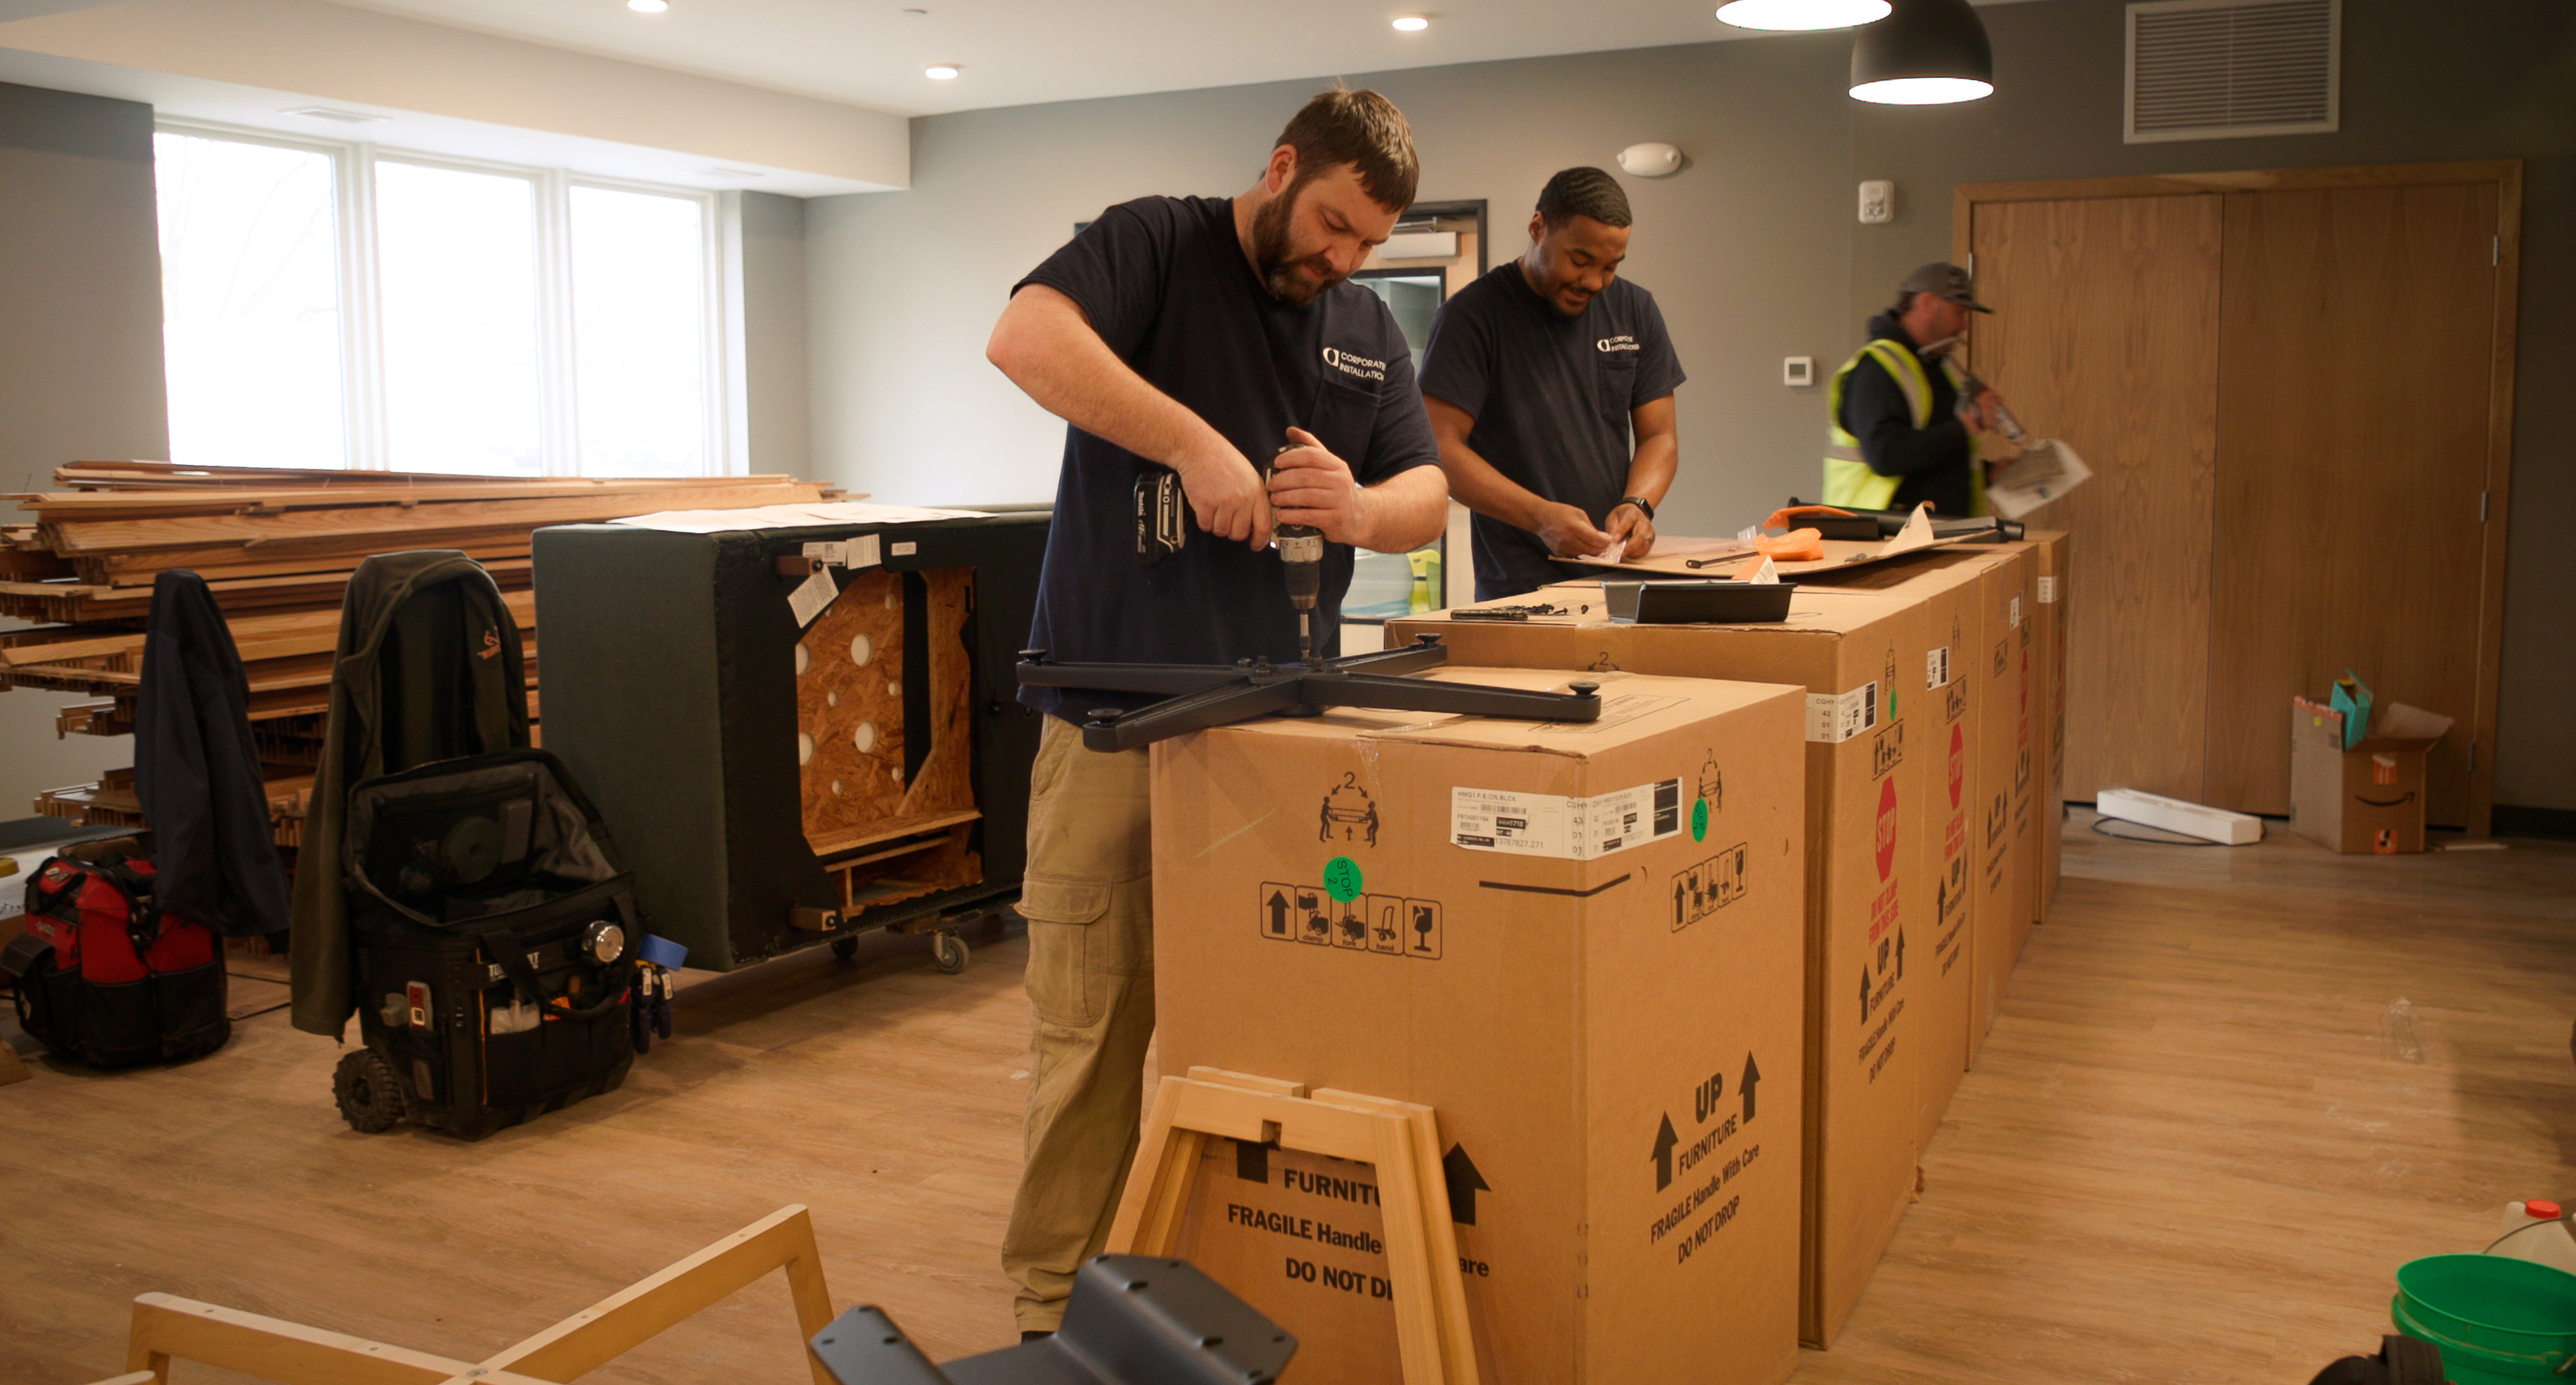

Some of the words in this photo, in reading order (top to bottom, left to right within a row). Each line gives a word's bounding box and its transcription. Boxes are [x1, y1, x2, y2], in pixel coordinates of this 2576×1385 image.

[1341, 352, 1387, 371] CORPORATE
[1599, 652, 1609, 666] 2
[1344, 771, 1356, 789] 2
[1328, 877, 1338, 886] 2
[1337, 860, 1353, 898] STOP
[1878, 937, 1889, 976] UP
[1695, 1073, 1723, 1124] UP
[1679, 1113, 1738, 1177] FURNITURE
[1284, 1168, 1381, 1208] FURNIT
[1651, 1195, 1692, 1245] FRAGILE
[1693, 1174, 1721, 1211] Handle
[1723, 1156, 1741, 1185] With
[1742, 1143, 1760, 1168] Care
[1228, 1203, 1313, 1239] FRAGILE
[1317, 1221, 1383, 1254] Handle
[1459, 1257, 1490, 1277] are
[1678, 1236, 1692, 1265] DO
[1695, 1218, 1715, 1250] NOT
[1714, 1195, 1739, 1232] DROP
[1285, 1256, 1316, 1283] DO
[1323, 1265, 1366, 1295] NOT
